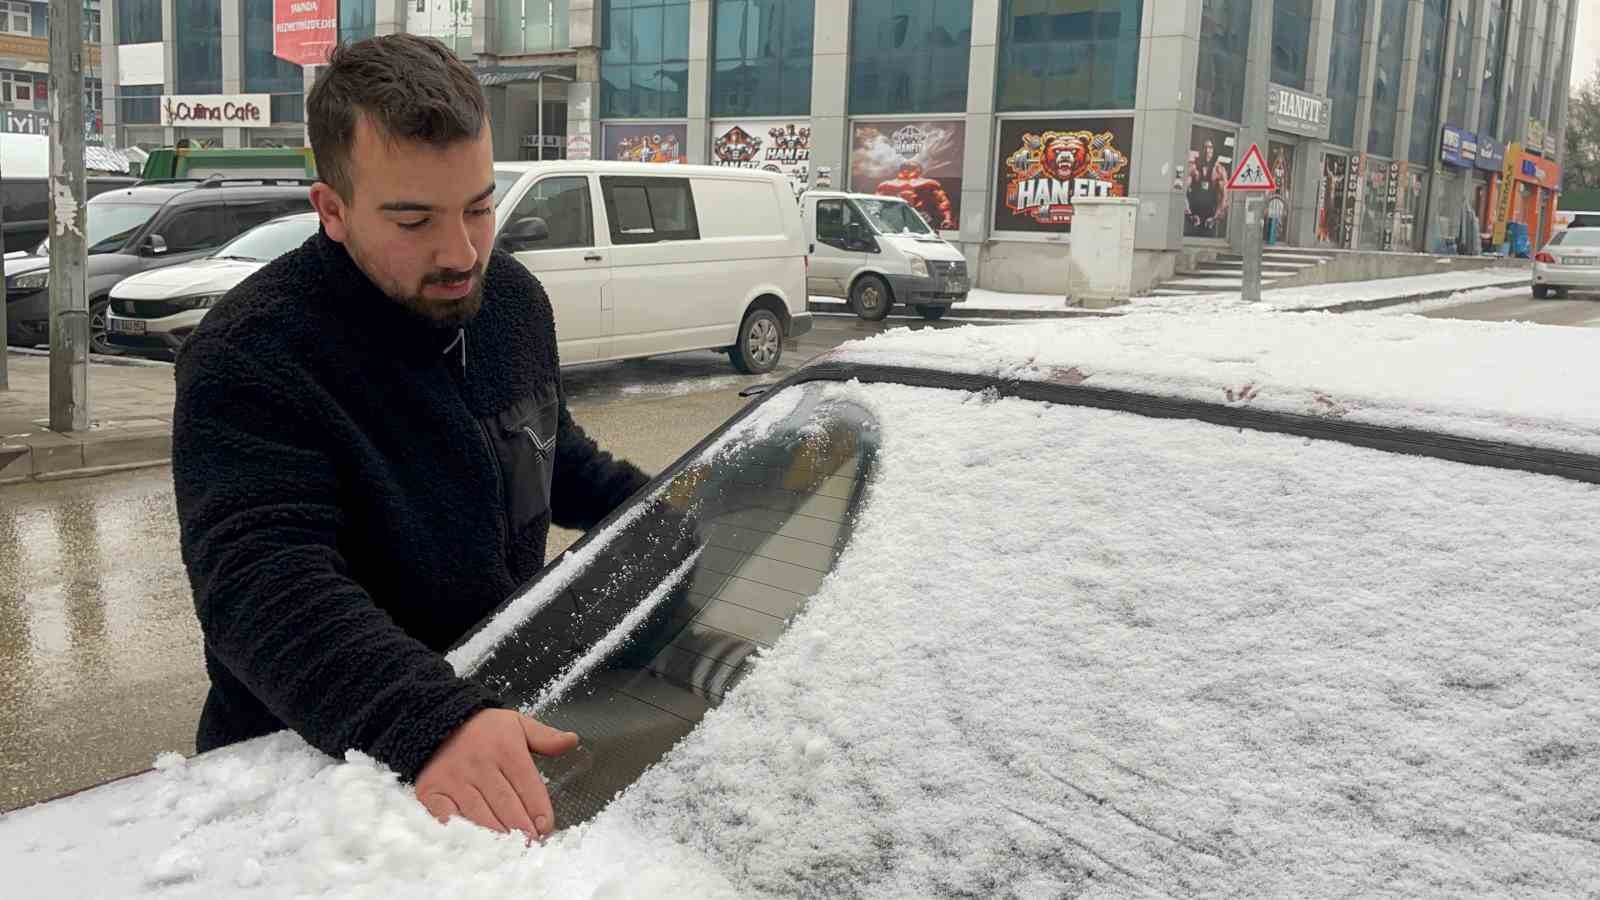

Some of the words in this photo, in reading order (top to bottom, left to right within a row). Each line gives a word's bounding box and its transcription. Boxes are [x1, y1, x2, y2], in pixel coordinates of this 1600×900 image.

[224, 102, 260, 121] Cafe
[1279, 90, 1321, 123] HANFIT
[767, 148, 795, 160] HAN
[1018, 177, 1070, 209] HAN
[1072, 178, 1112, 197] FIT
